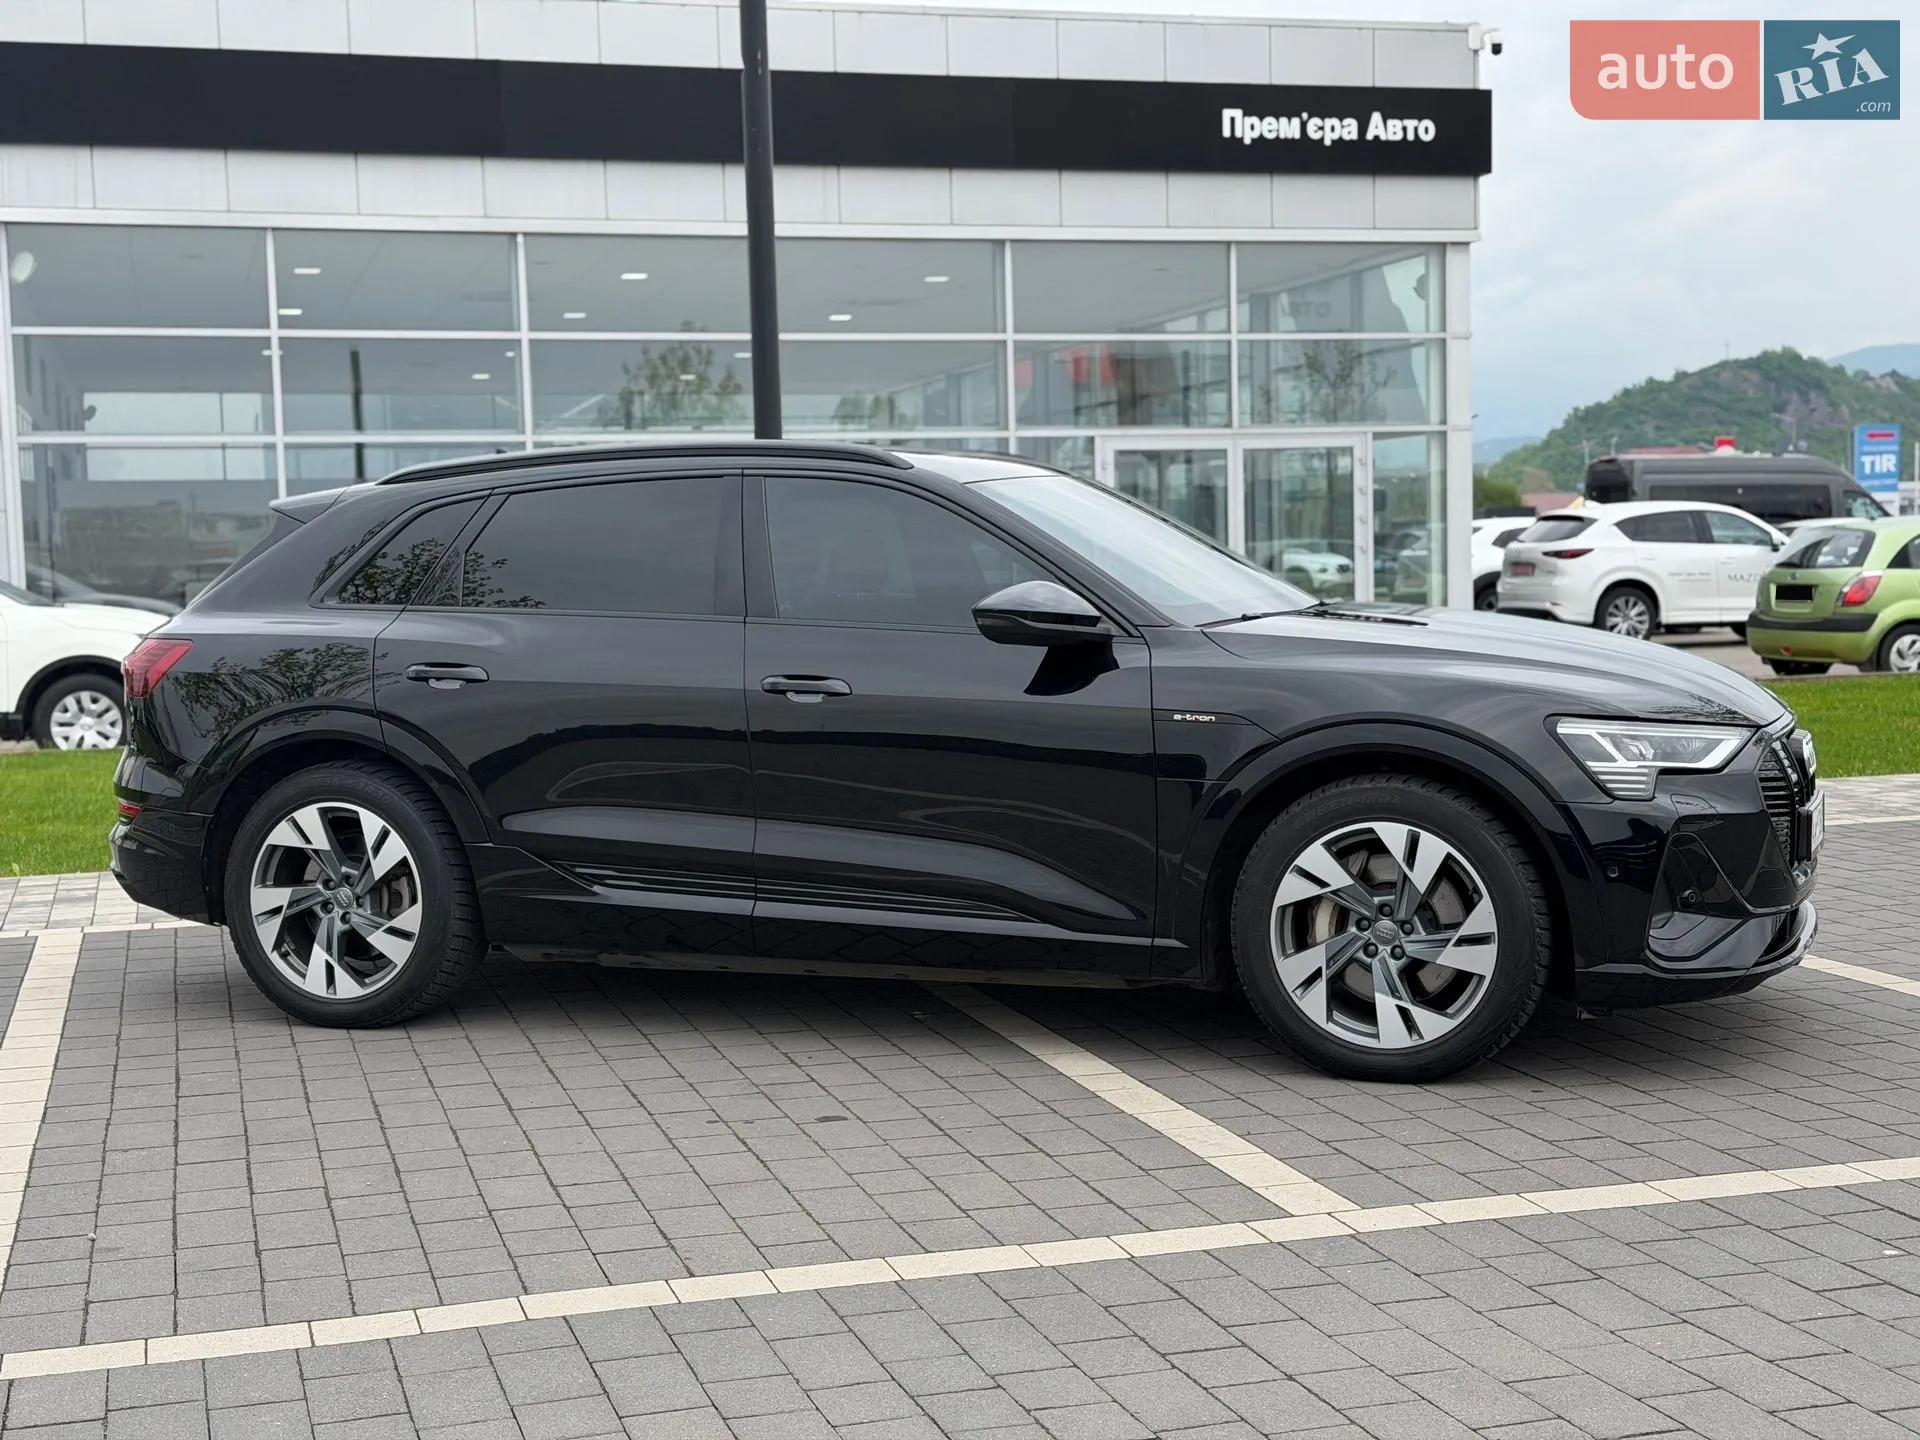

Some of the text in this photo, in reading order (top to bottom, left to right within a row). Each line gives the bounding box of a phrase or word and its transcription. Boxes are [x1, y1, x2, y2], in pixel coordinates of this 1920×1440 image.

[1221, 107, 1437, 147] Прем'єра Авто
[1860, 453, 1897, 475] TIR
[1727, 573, 1761, 583] MAZD
[1173, 713, 1216, 722] e-tron
